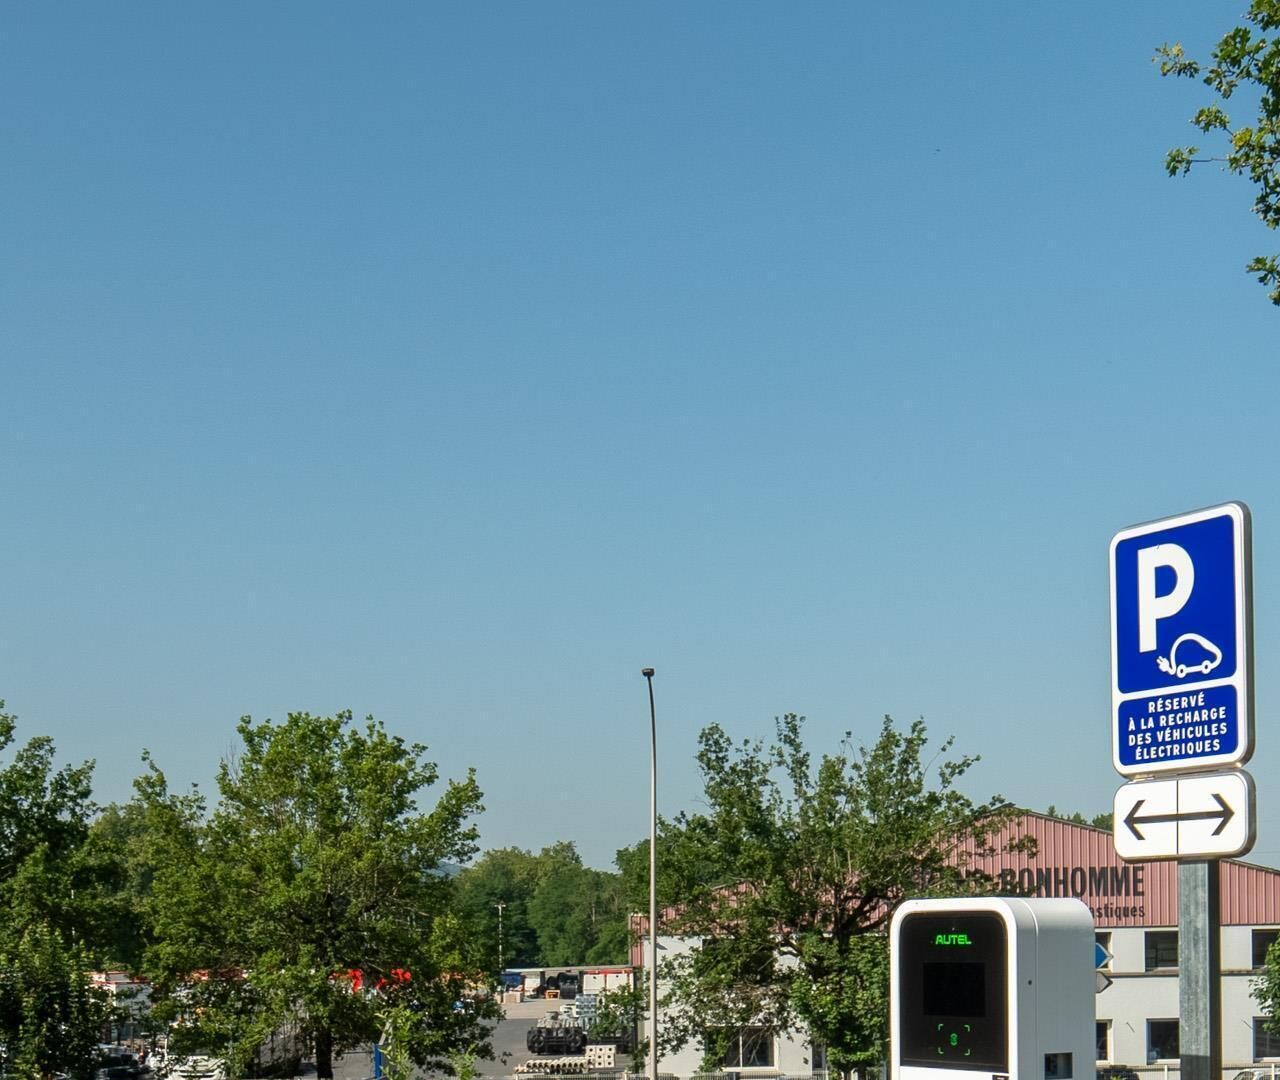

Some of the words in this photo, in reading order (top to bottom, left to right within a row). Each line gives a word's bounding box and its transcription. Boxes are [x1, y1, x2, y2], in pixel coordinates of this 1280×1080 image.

[1137, 543, 1195, 653] P
[1148, 692, 1205, 713] RÉSERVÉ
[1128, 717, 1136, 731] À
[1140, 717, 1154, 730] LA
[1159, 706, 1226, 727] RECHARGE
[1128, 732, 1151, 746] DES
[1157, 722, 1227, 742] VÉHICULES
[1135, 739, 1220, 760] ÉLECTRIQUES
[1001, 866, 1145, 898] BONHOMME
[1088, 902, 1145, 921] astiques
[935, 934, 972, 945] AUTEL
